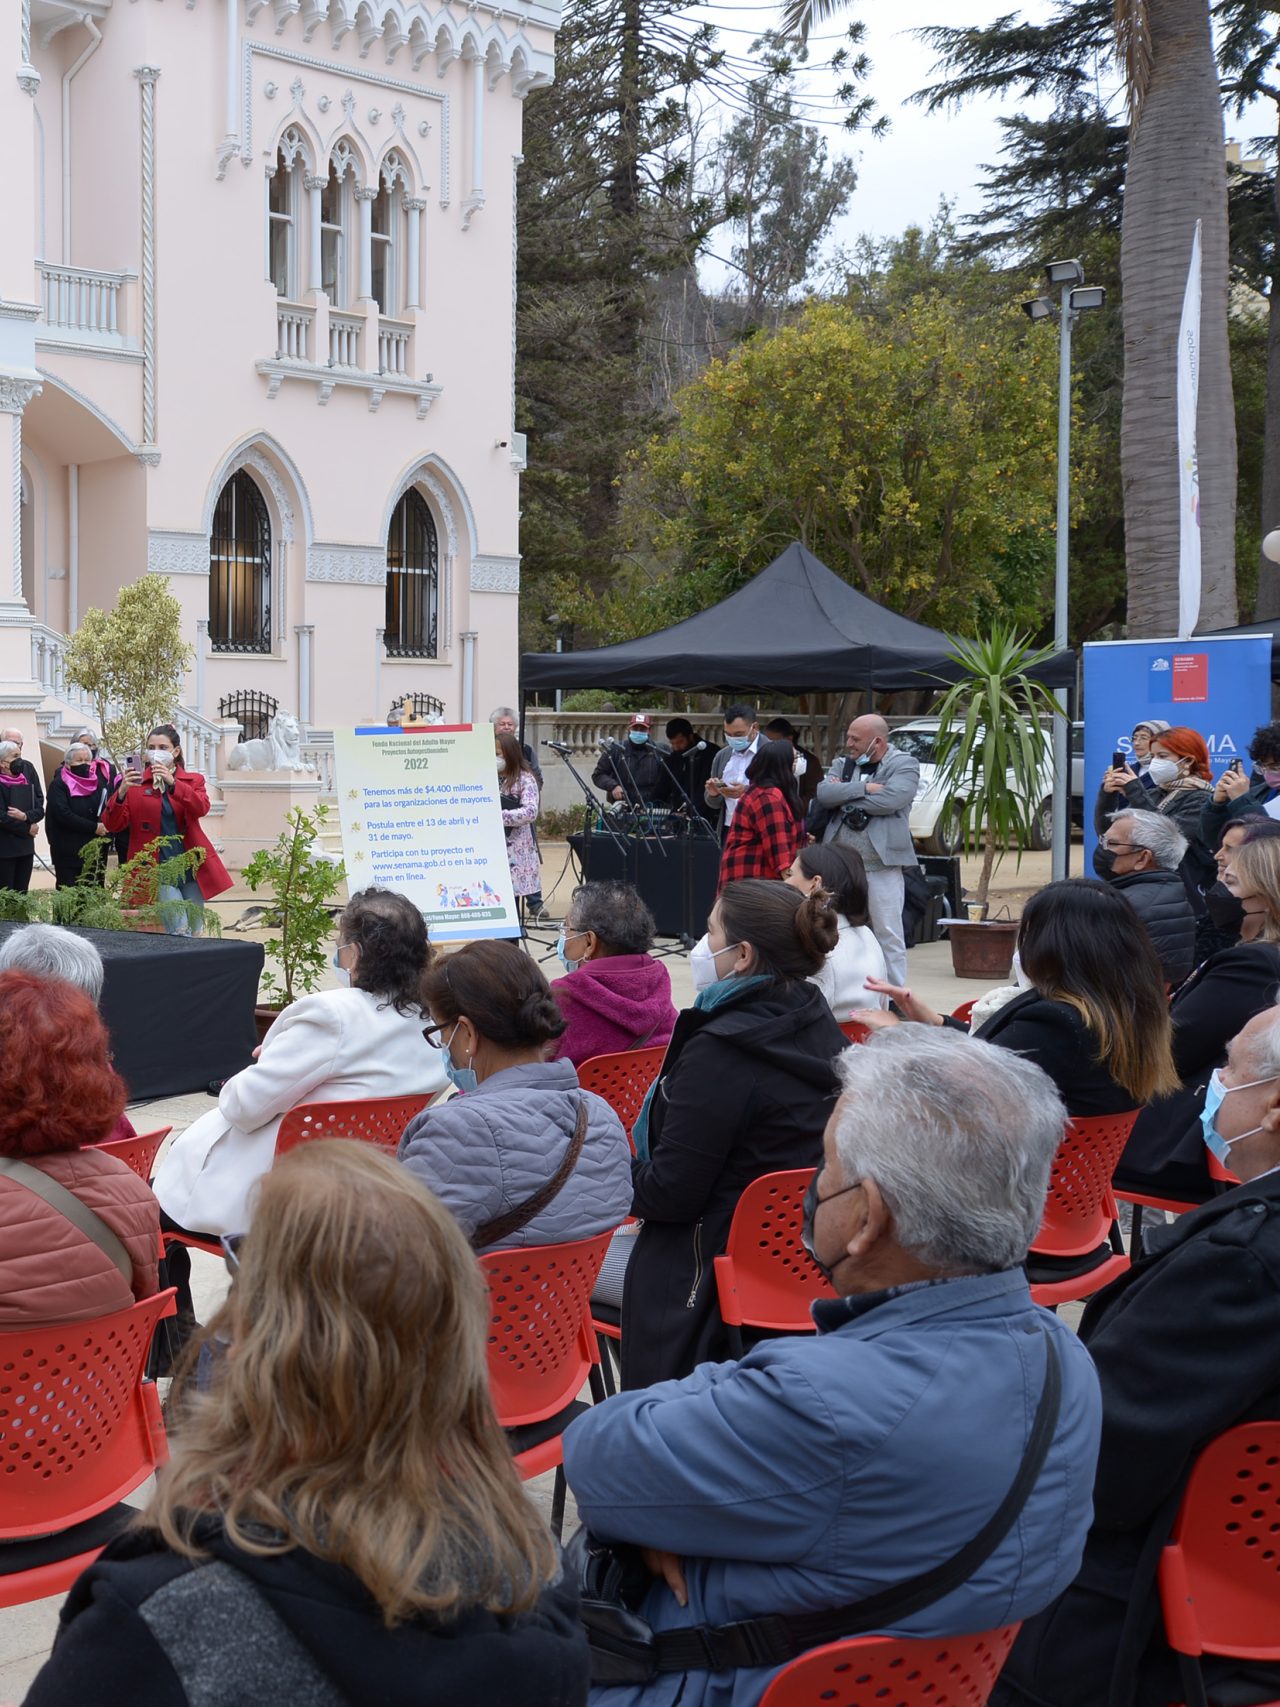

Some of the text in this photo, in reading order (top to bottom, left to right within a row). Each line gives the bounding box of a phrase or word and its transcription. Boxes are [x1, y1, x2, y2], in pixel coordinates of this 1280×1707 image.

[407, 747, 448, 755] Autogestionados
[404, 758, 428, 770] 2022
[363, 784, 483, 796] Tenemos más de $4.400 millones
[364, 801, 380, 810] para
[382, 800, 393, 808] las
[394, 799, 448, 808] organizaciones
[460, 795, 493, 806] mayores.
[367, 821, 394, 830] Postula
[396, 820, 416, 828] entre
[417, 819, 424, 827] el
[426, 819, 436, 827] 13
[438, 818, 447, 826] de
[449, 817, 464, 825] abril
[472, 816, 479, 824] el
[368, 833, 378, 842] 31
[380, 833, 390, 841] de
[371, 850, 404, 859] Participa
[406, 849, 419, 857] con
[421, 848, 428, 856] tu
[431, 848, 463, 856] proyecto
[372, 859, 446, 870] www.senama.gob.cl
[406, 872, 426, 880] línea.
